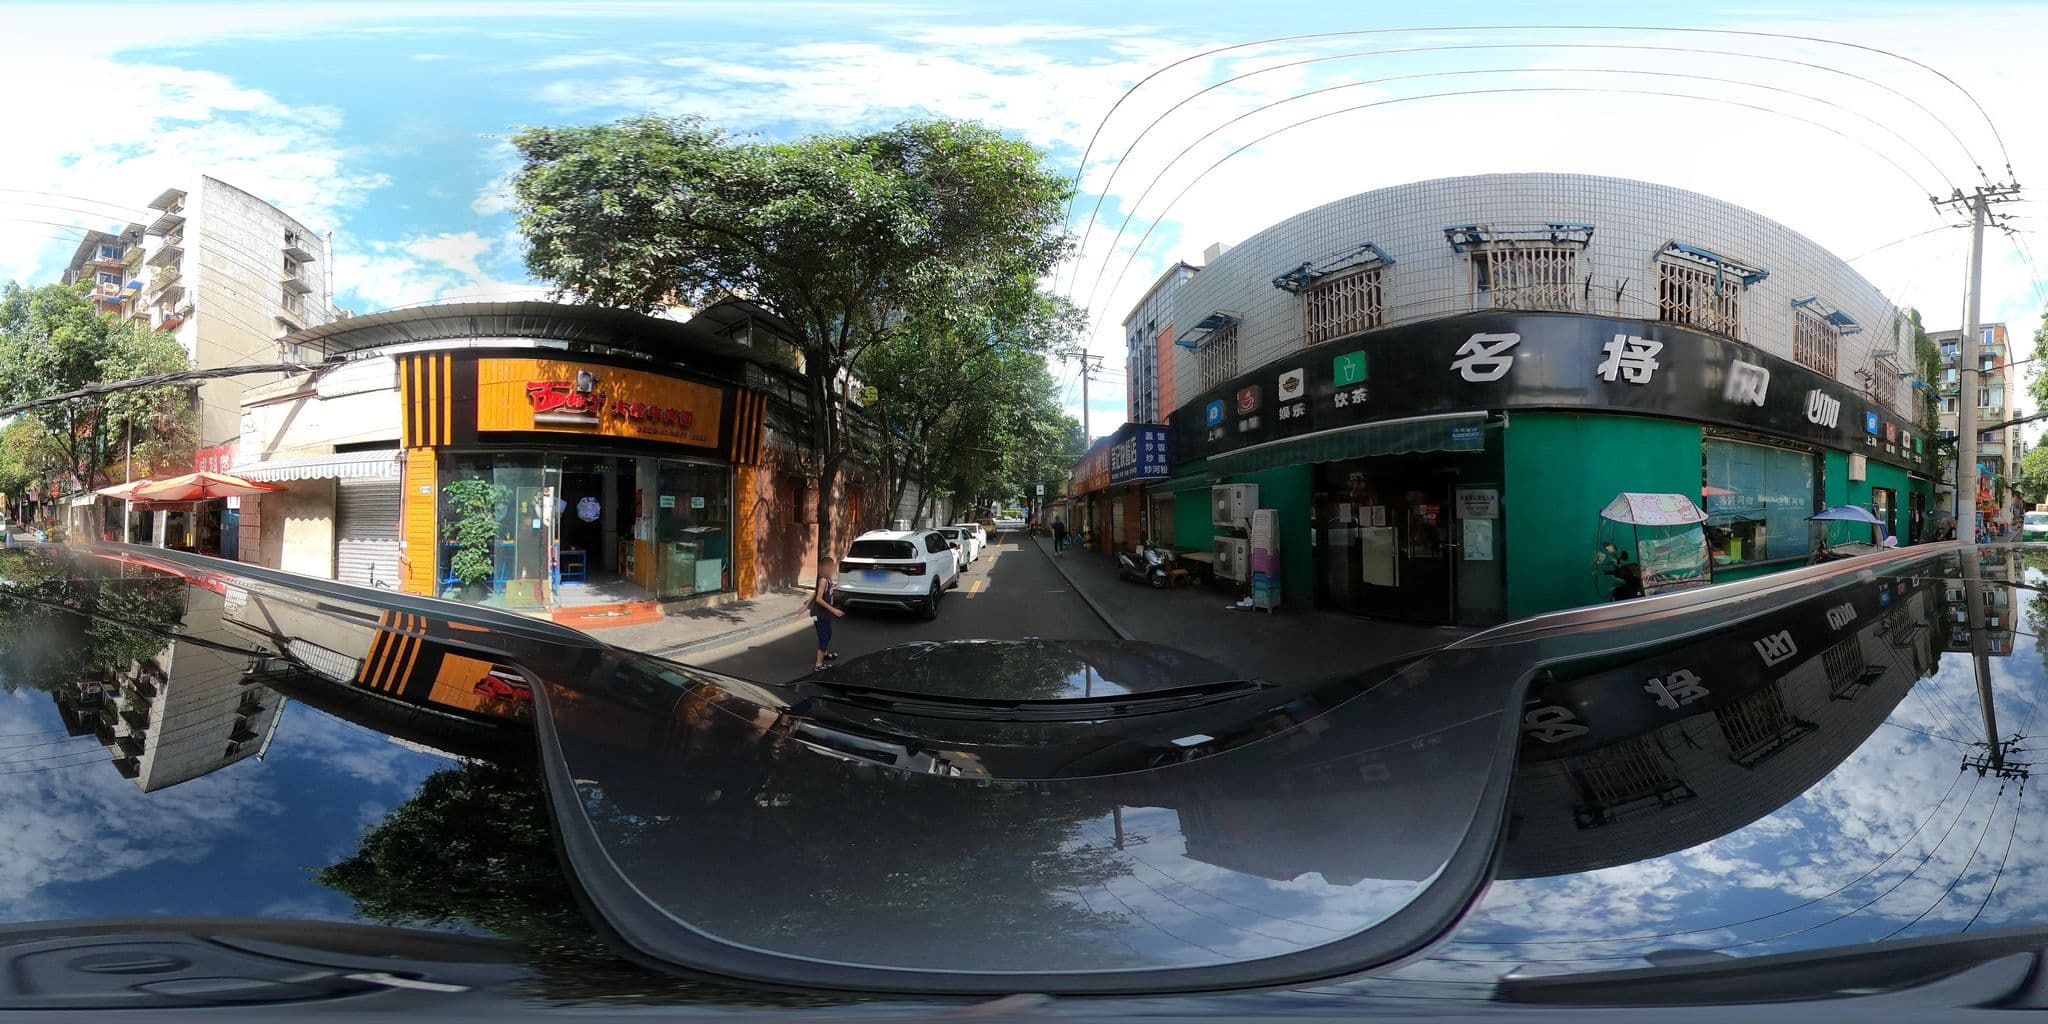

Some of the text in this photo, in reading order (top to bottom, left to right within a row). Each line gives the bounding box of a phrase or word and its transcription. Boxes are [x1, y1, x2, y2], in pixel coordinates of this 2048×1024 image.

[1449, 332, 1841, 430] 名将网咖
[1334, 387, 1368, 408] 饮茶
[1279, 403, 1306, 421] 娱乐
[1145, 443, 1165, 452] 炒饭
[1145, 454, 1166, 462] 炒面
[1144, 465, 1168, 474] 炒河粉
